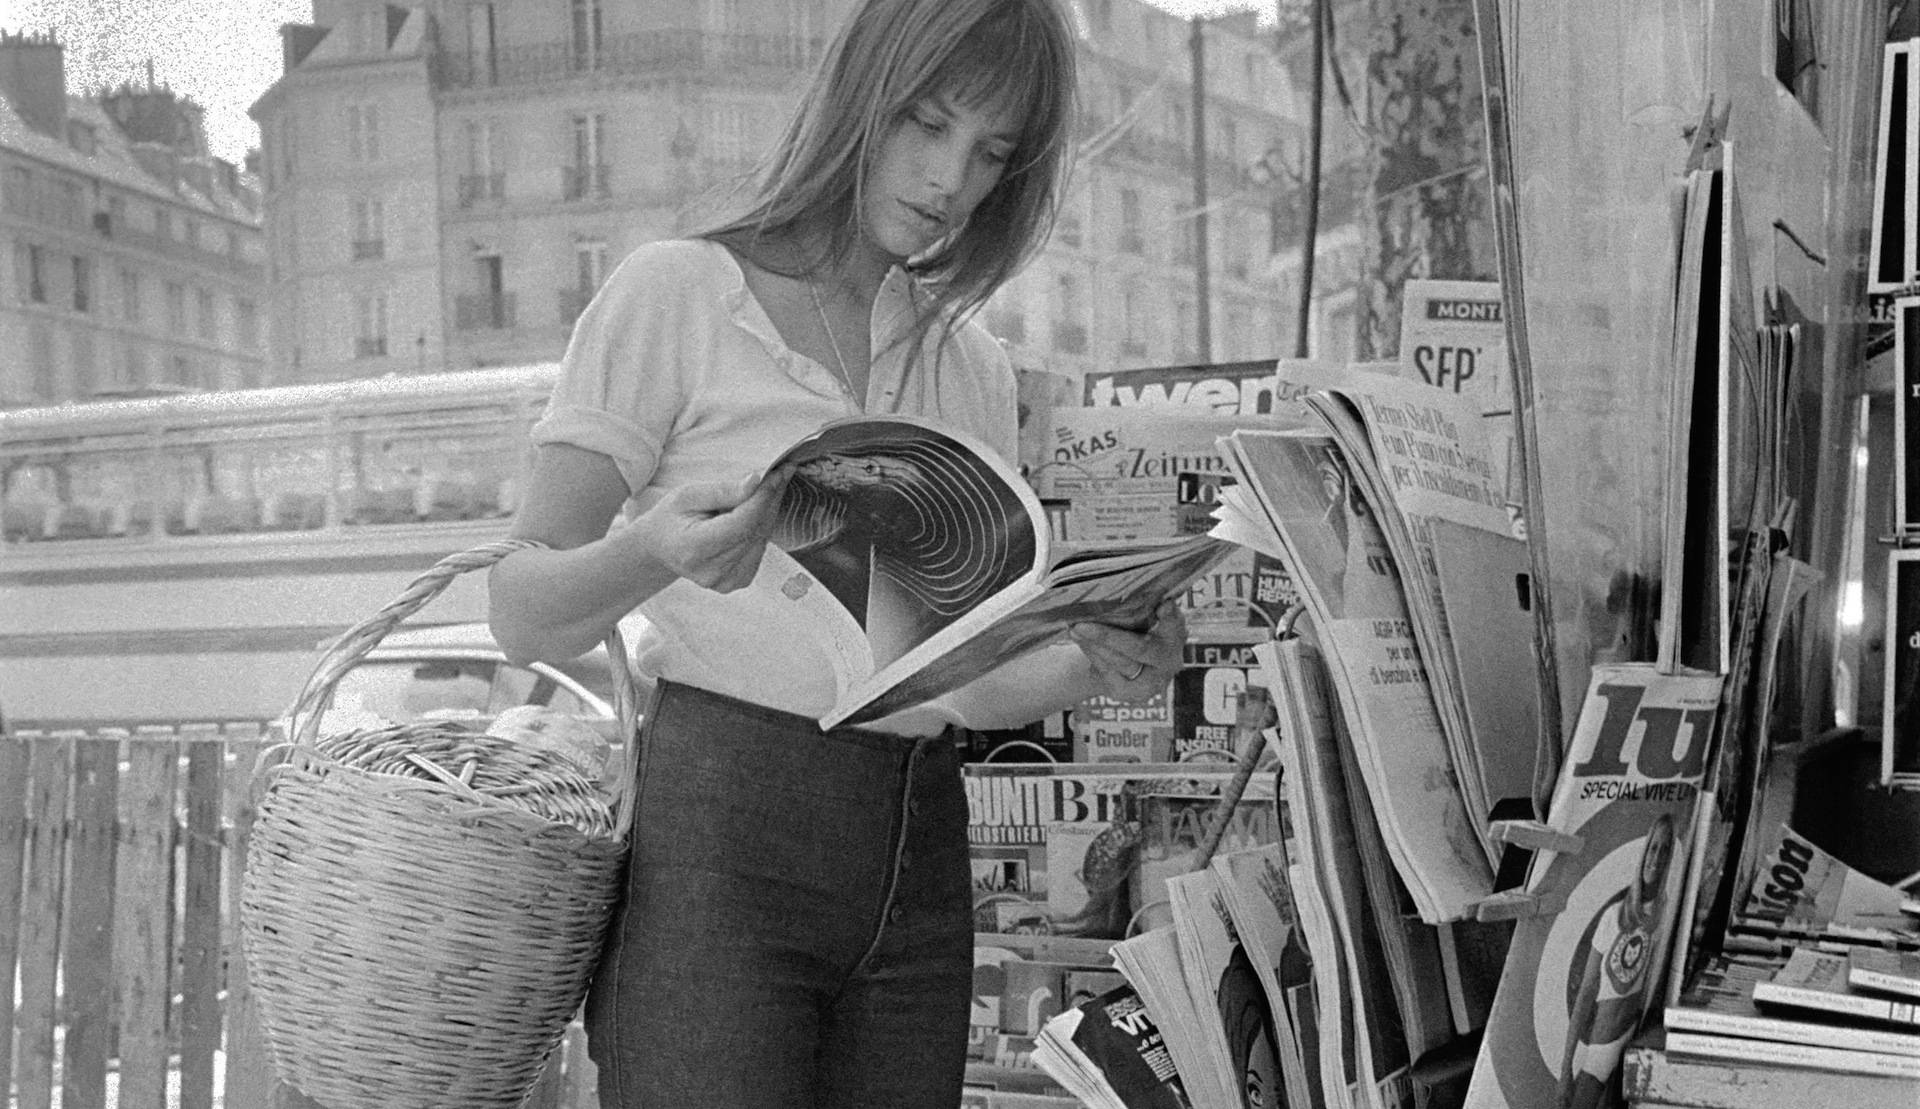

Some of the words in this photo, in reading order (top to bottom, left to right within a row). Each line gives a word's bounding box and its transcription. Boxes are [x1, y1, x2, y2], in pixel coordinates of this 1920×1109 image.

[1092, 376, 1277, 416] twen
[1128, 448, 1232, 478] Zeitun
[1195, 726, 1228, 740] FREE
[1581, 782, 1640, 800] SPECIAL
[1645, 784, 1677, 801] VIVE
